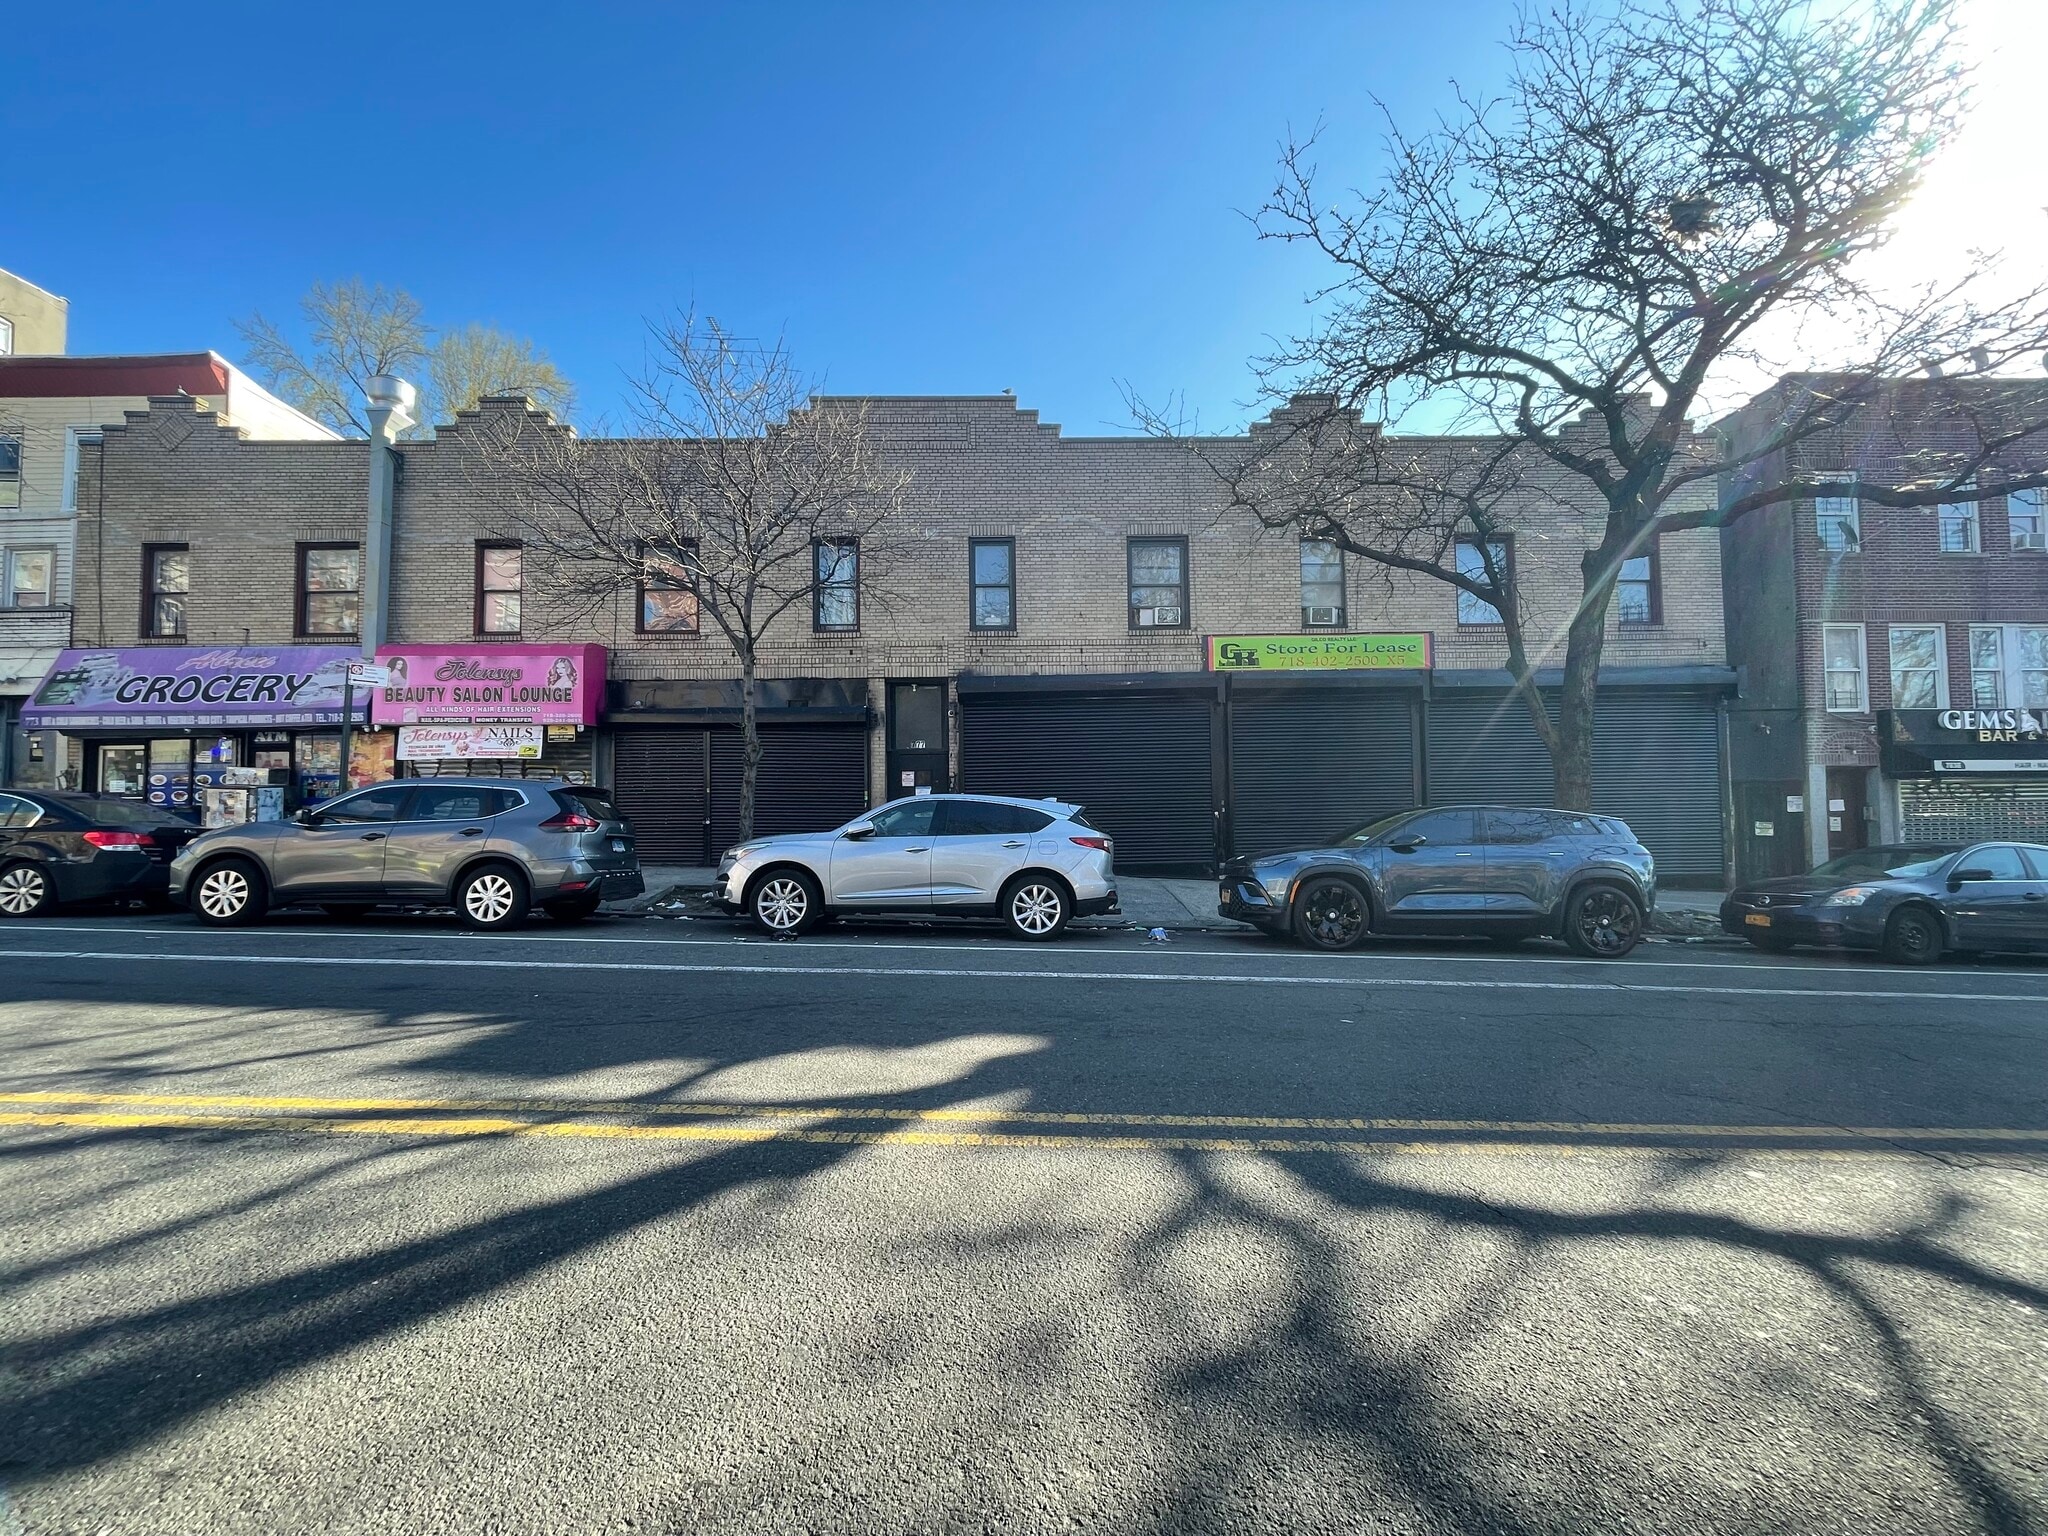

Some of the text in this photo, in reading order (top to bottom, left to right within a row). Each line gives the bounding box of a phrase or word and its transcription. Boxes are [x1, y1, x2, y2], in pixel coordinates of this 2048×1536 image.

[1266, 642, 1417, 655] Store For Lease
[1279, 655, 1405, 667] 718-402-2500 X5
[114, 673, 313, 705] GROCERY
[385, 686, 573, 704] BEAUTY SALON LOUNGE
[1943, 709, 2017, 730] GEMS
[254, 731, 288, 742] ATM
[488, 727, 533, 738] NAILS
[1979, 730, 2038, 742] BAR &
